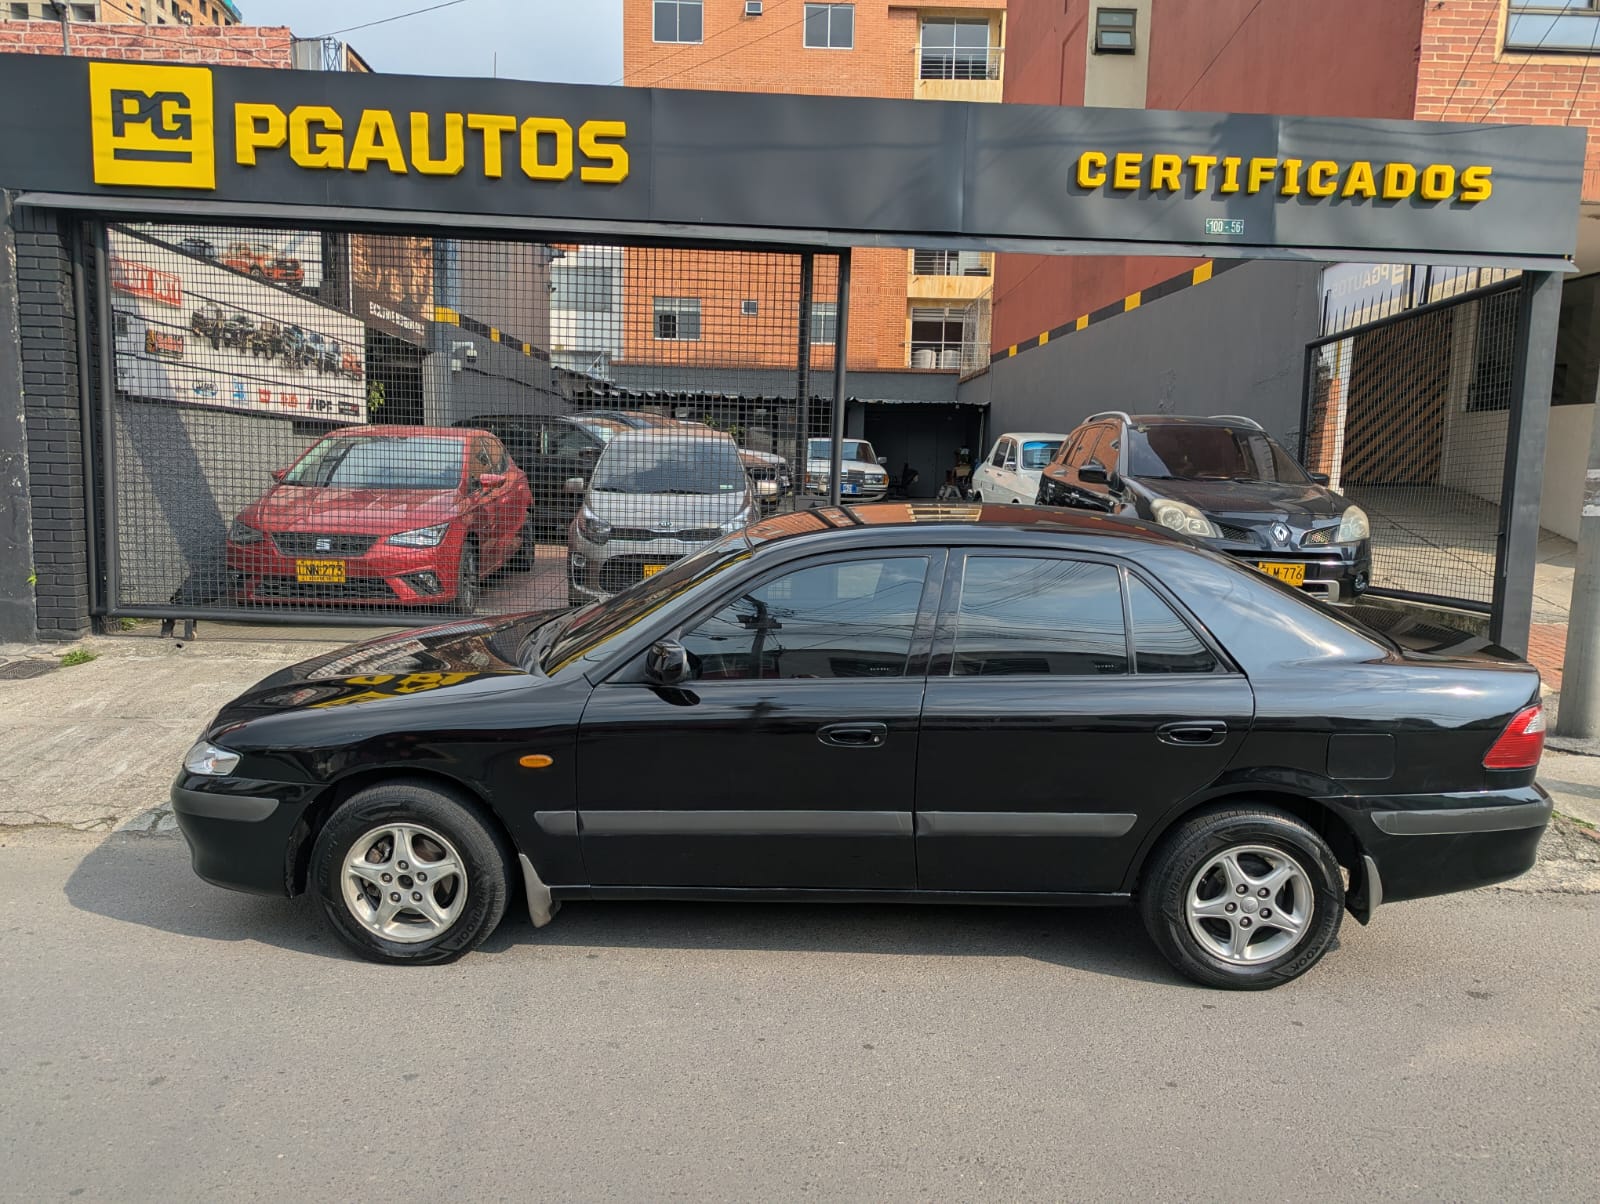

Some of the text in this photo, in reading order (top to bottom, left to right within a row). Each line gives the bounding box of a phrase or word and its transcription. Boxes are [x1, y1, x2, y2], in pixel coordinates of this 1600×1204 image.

[110, 88, 192, 141] PG
[234, 102, 630, 184] PGAUTOS
[1076, 151, 1494, 203] CERTIFICADOS
[1210, 220, 1223, 232] 100
